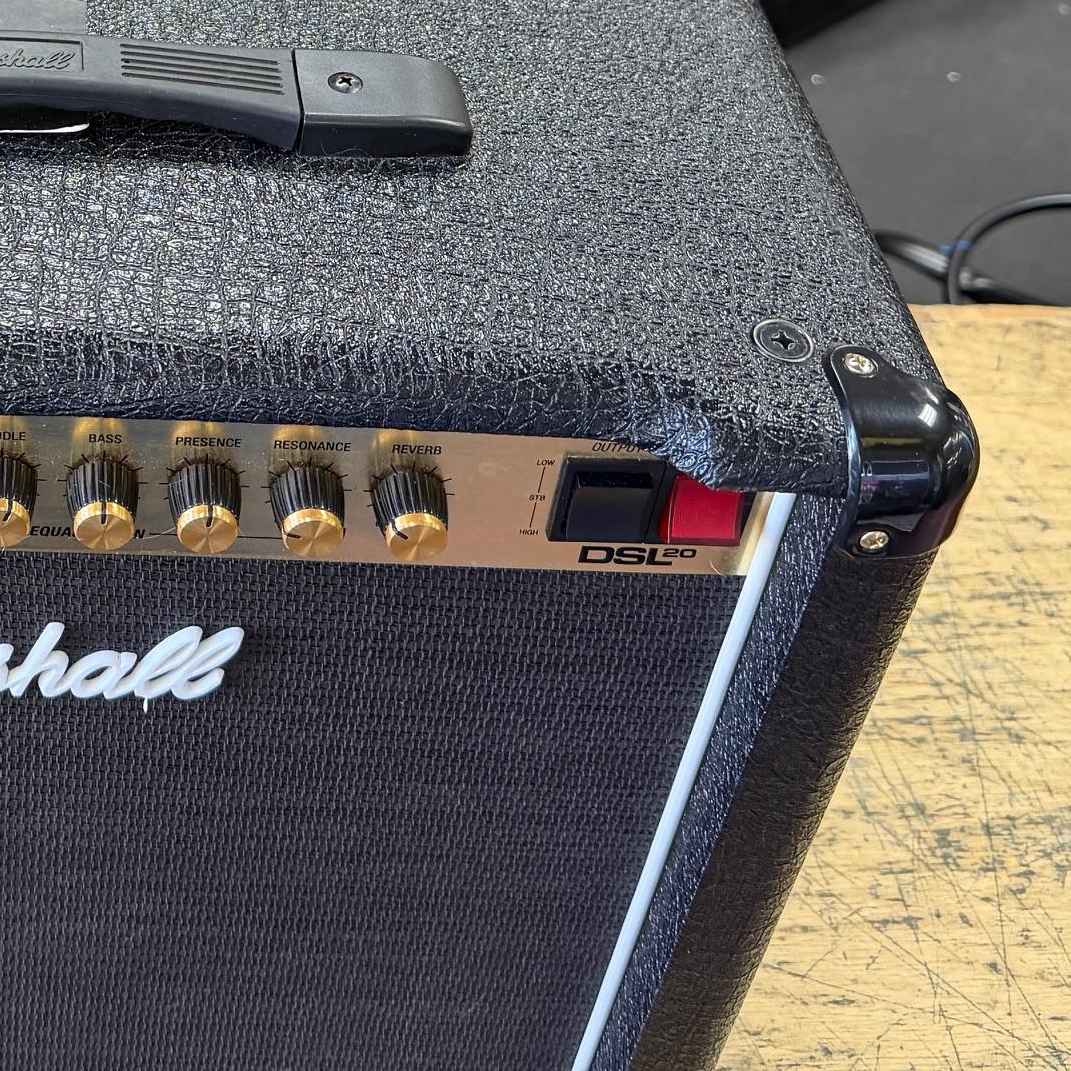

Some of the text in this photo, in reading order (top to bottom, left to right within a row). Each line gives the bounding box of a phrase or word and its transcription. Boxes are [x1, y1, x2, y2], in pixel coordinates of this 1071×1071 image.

[88, 433, 122, 444] BASS
[175, 436, 242, 448] PRESENCE
[273, 440, 352, 452] RESONANCE
[392, 444, 442, 455] REVERB
